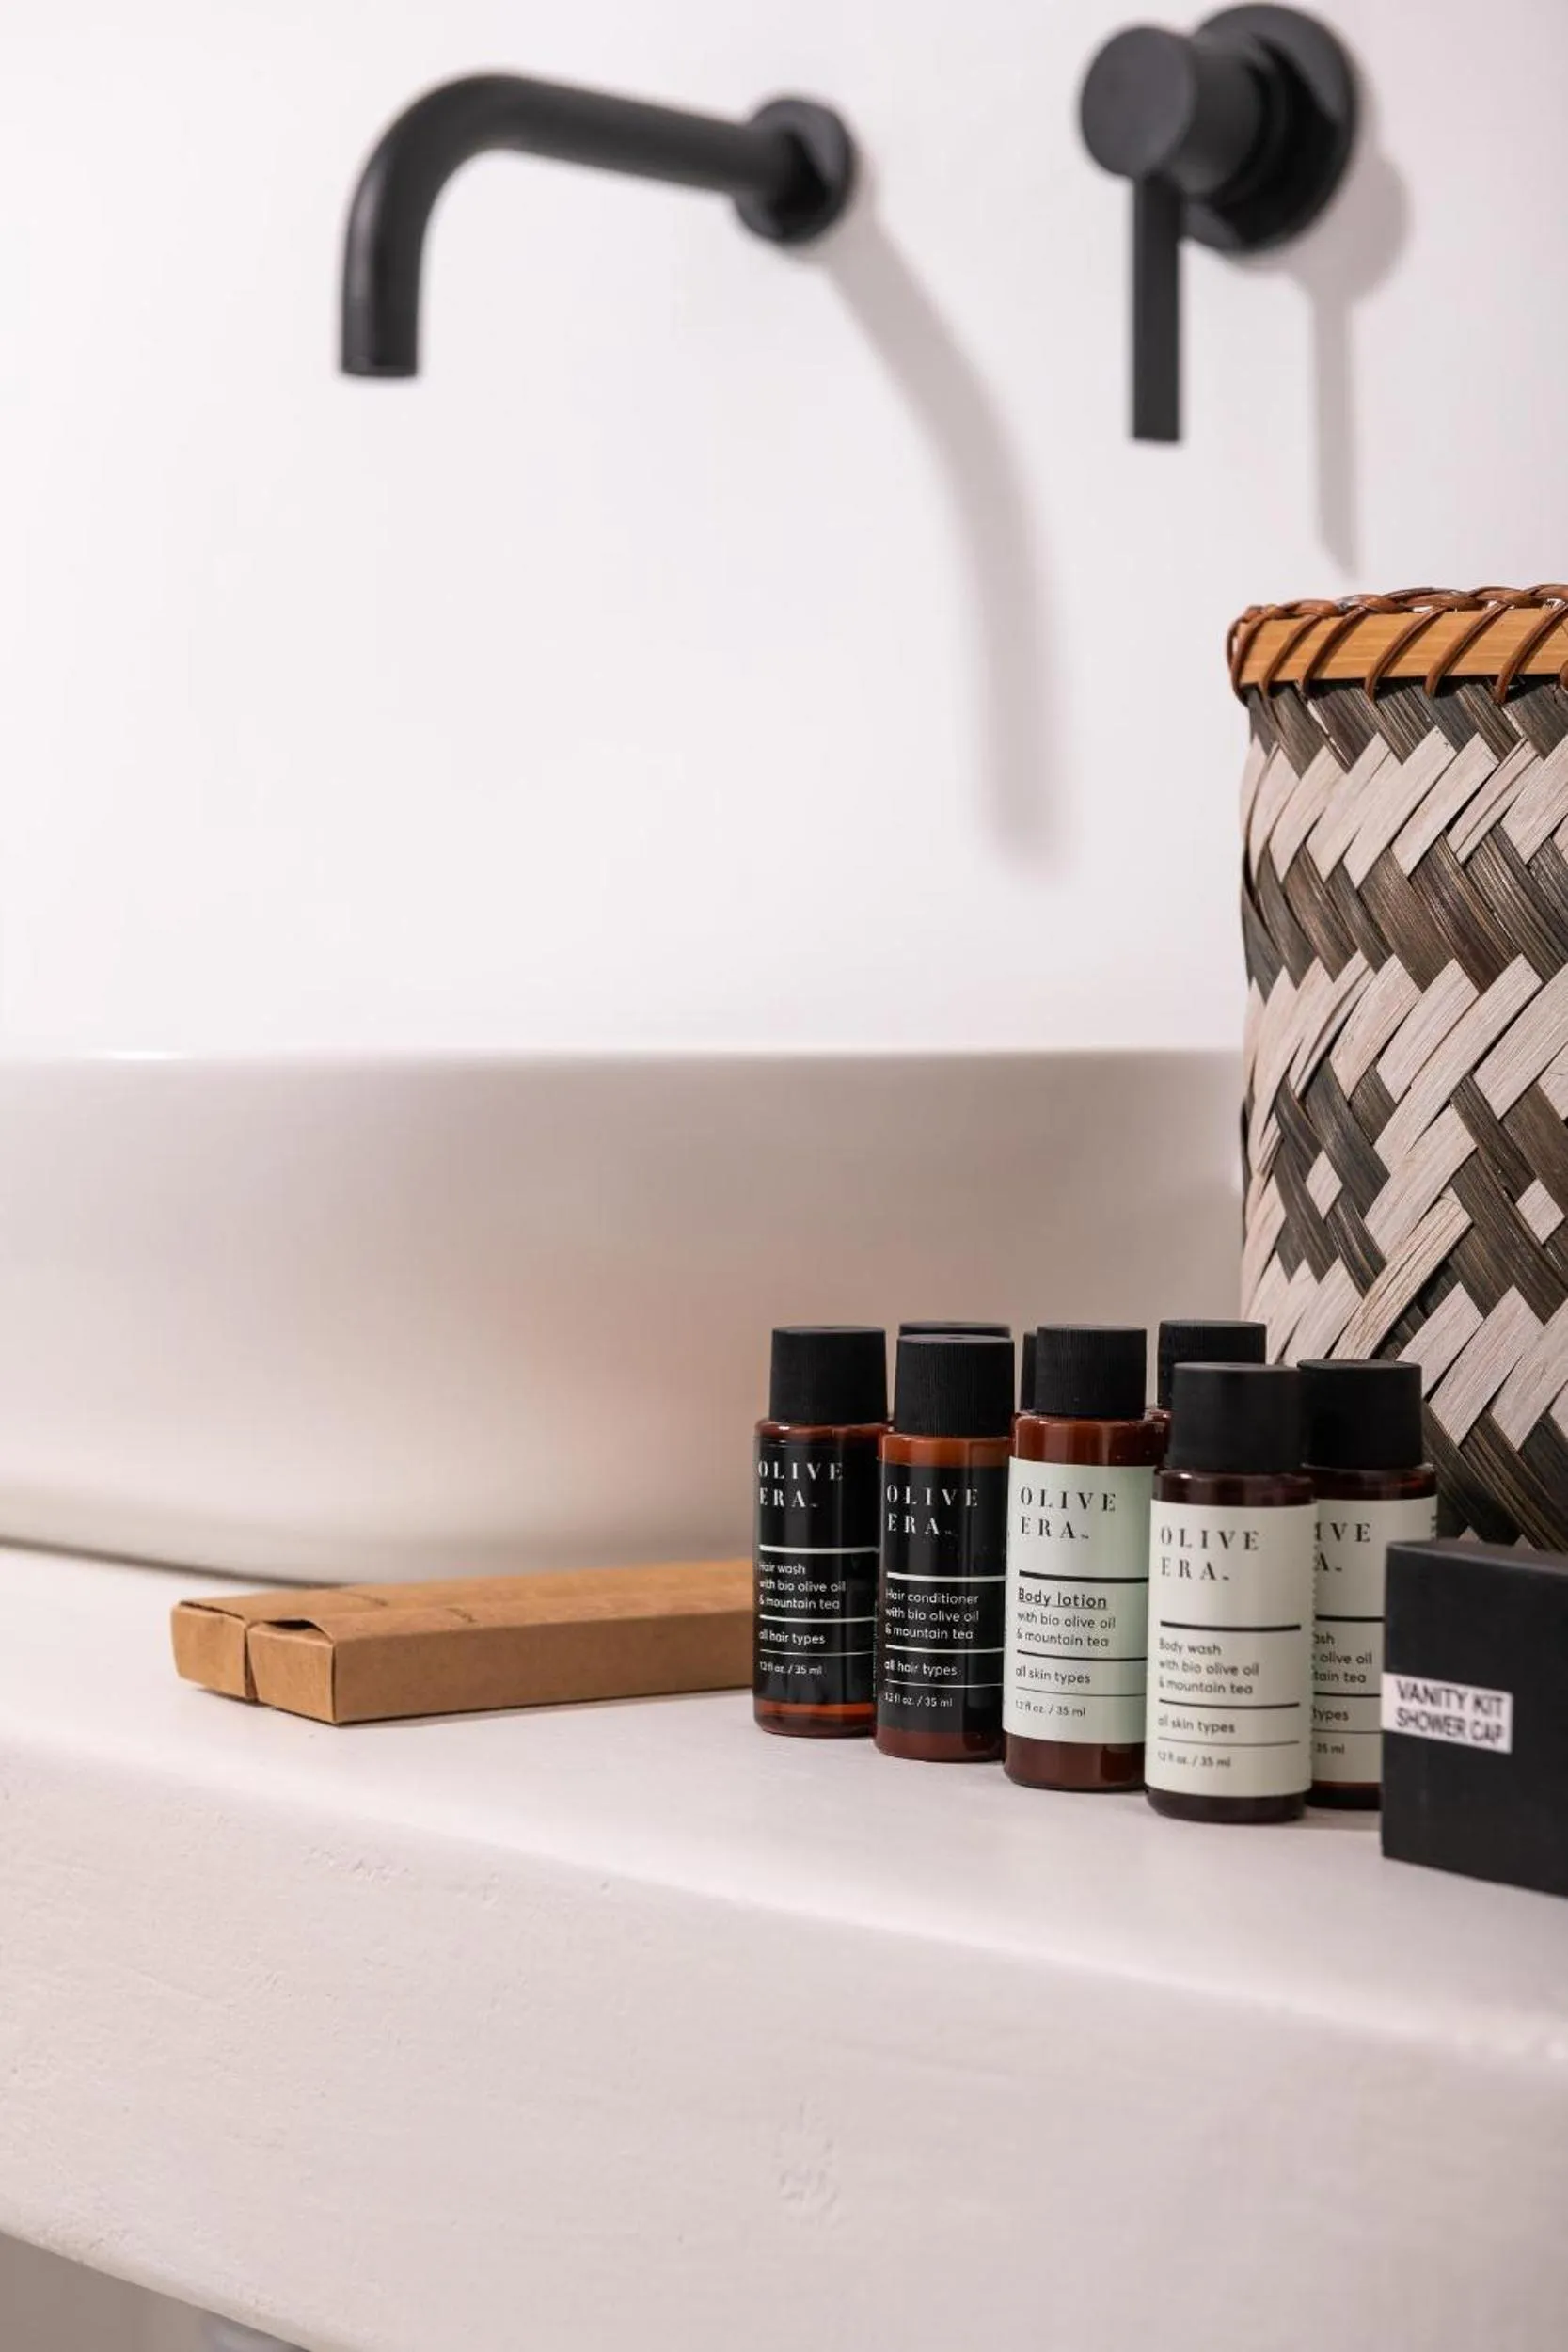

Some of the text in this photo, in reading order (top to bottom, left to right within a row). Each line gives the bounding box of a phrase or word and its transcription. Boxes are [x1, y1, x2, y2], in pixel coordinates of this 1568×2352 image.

[758, 1460, 843, 1480] OLIVE
[887, 1484, 978, 1506] OLIVE
[1021, 1486, 1116, 1512] OLIVE
[1161, 1526, 1259, 1550] OLIVE
[1315, 1522, 1370, 1542] IVE
[777, 1564, 806, 1575] wash
[777, 1580, 795, 1591] bio
[797, 1581, 827, 1592] olive
[830, 1581, 847, 1592] oil
[766, 1597, 816, 1609] mountain
[819, 1599, 840, 1610] tea
[885, 1588, 979, 1604] Hair conditioner
[1018, 1587, 1107, 1609] Body lotion
[885, 1606, 979, 1622] with bio olive oil
[1018, 1611, 1116, 1629] with bio olive oil
[759, 1629, 826, 1645] all hair types
[893, 1627, 948, 1639] mountain
[953, 1629, 974, 1639] tea
[1024, 1631, 1083, 1646] mountain
[1087, 1636, 1109, 1647] tea
[1159, 1636, 1222, 1655] Body wash
[1320, 1652, 1372, 1664] olive oil
[794, 1664, 807, 1674] 35
[809, 1665, 822, 1675] ml
[884, 1659, 958, 1677] all hair types
[1015, 1665, 1091, 1685] all skin types
[1159, 1660, 1259, 1676] with bio olive oil
[1344, 1672, 1367, 1683] tea
[1167, 1679, 1226, 1693] mountain
[1230, 1682, 1253, 1694] tea
[925, 1696, 937, 1707] 35
[940, 1698, 953, 1708] ml
[1397, 1680, 1504, 1718] VANITY KIT
[1313, 1708, 1349, 1723] types
[1158, 1714, 1236, 1735] all skin types
[1396, 1707, 1503, 1744] SHOWER CAP
[1330, 1744, 1345, 1755] ml
